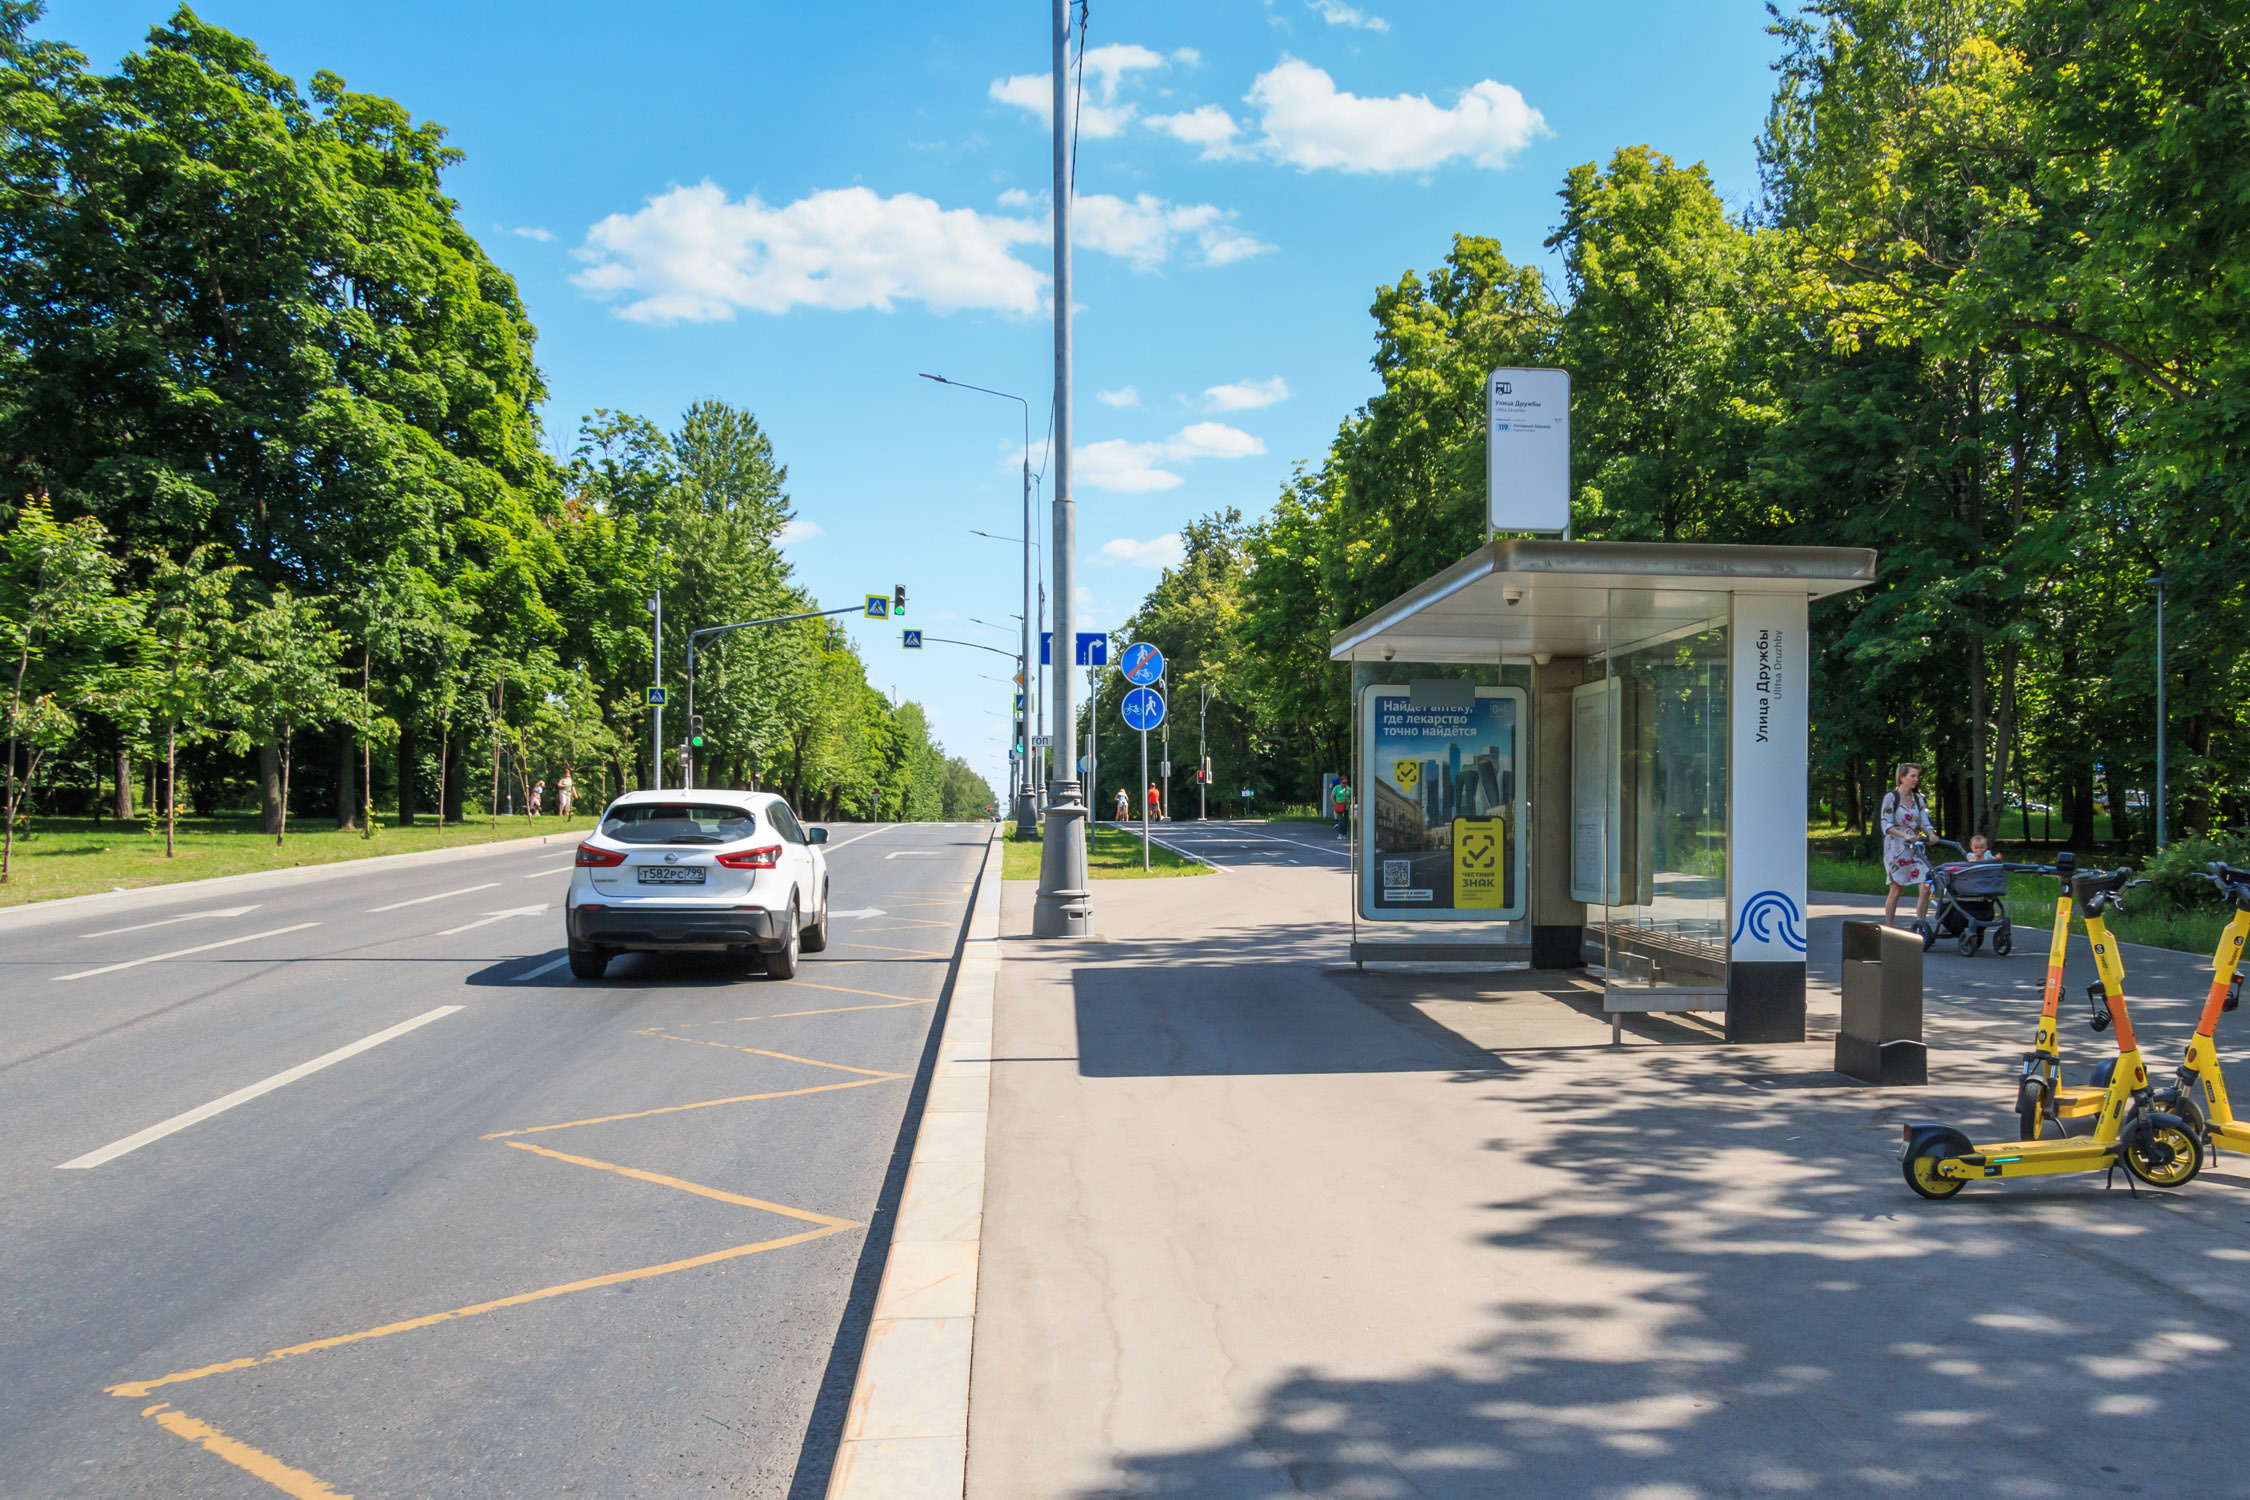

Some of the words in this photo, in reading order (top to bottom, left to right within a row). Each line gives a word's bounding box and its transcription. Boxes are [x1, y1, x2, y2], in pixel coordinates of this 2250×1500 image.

[1756, 629, 1771, 693] Дружбы
[1773, 630, 1783, 671] Druzhby
[1773, 673, 1782, 700] Ulitsa
[1383, 715, 1403, 725] где
[1406, 715, 1468, 726] лекарство
[1383, 727, 1419, 736] точно
[1422, 725, 1477, 737] найдётся
[1756, 698, 1770, 743] Улица
[1462, 879, 1495, 888] ЗНАК
